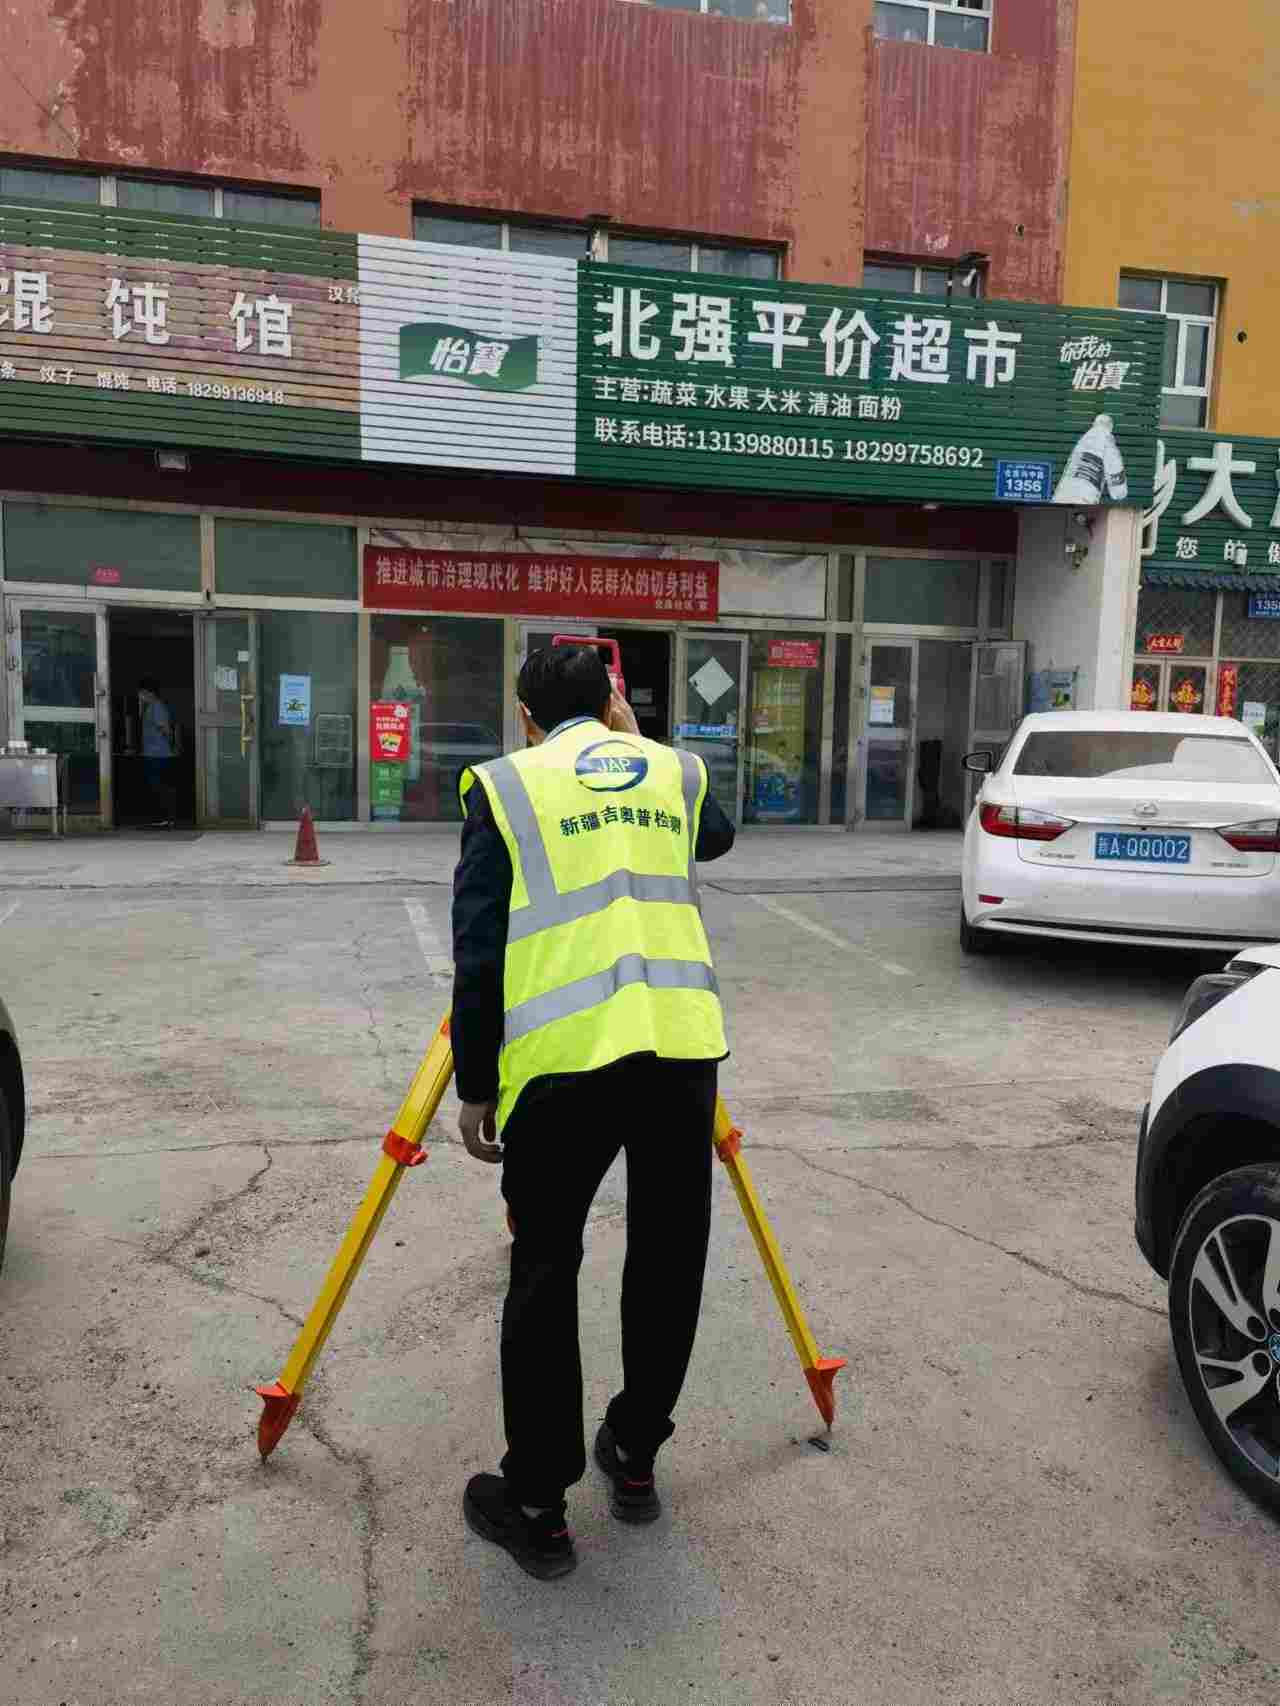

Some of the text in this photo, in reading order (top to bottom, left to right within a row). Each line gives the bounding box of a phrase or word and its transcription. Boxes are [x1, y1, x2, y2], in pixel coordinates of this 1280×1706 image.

[593, 286, 1022, 388] 北强平价超市
[147, 377, 177, 395] 电话
[595, 377, 902, 421] 主营:蔬菜 水果 大米 清油 面粉
[594, 416, 984, 469] 联系电话:13139880115 18299758692
[1006, 479, 1042, 492] 1356
[376, 556, 708, 599] 推进城市治理现代化 维护好人民群众的切身利益
[560, 805, 681, 836] 新疆吉奥普检测
